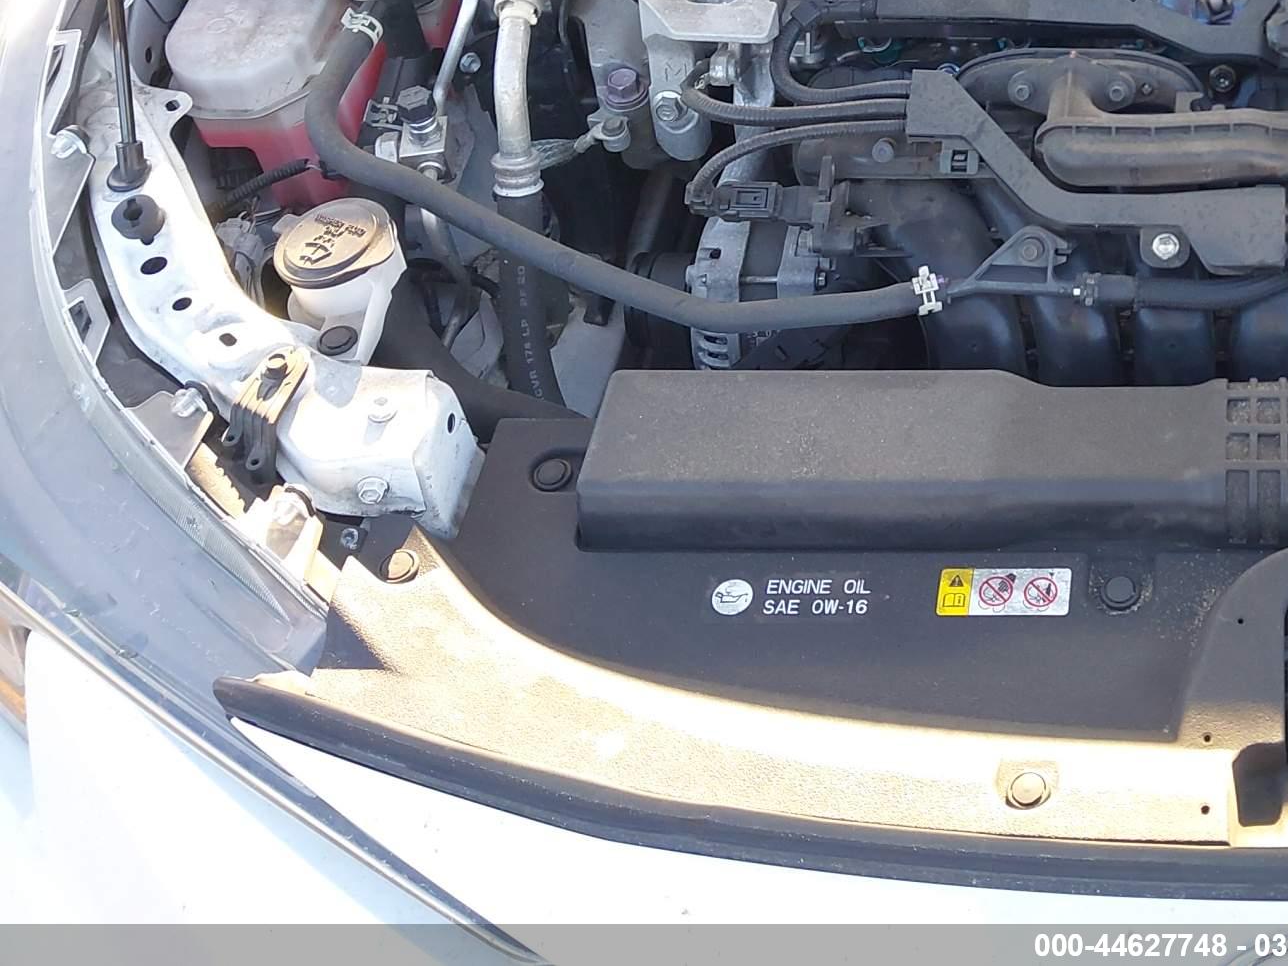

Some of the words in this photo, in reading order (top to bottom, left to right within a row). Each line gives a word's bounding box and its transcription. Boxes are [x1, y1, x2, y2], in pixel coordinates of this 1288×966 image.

[766, 579, 833, 595] ENGINE
[843, 579, 872, 595] OIL
[762, 599, 801, 615] SAE
